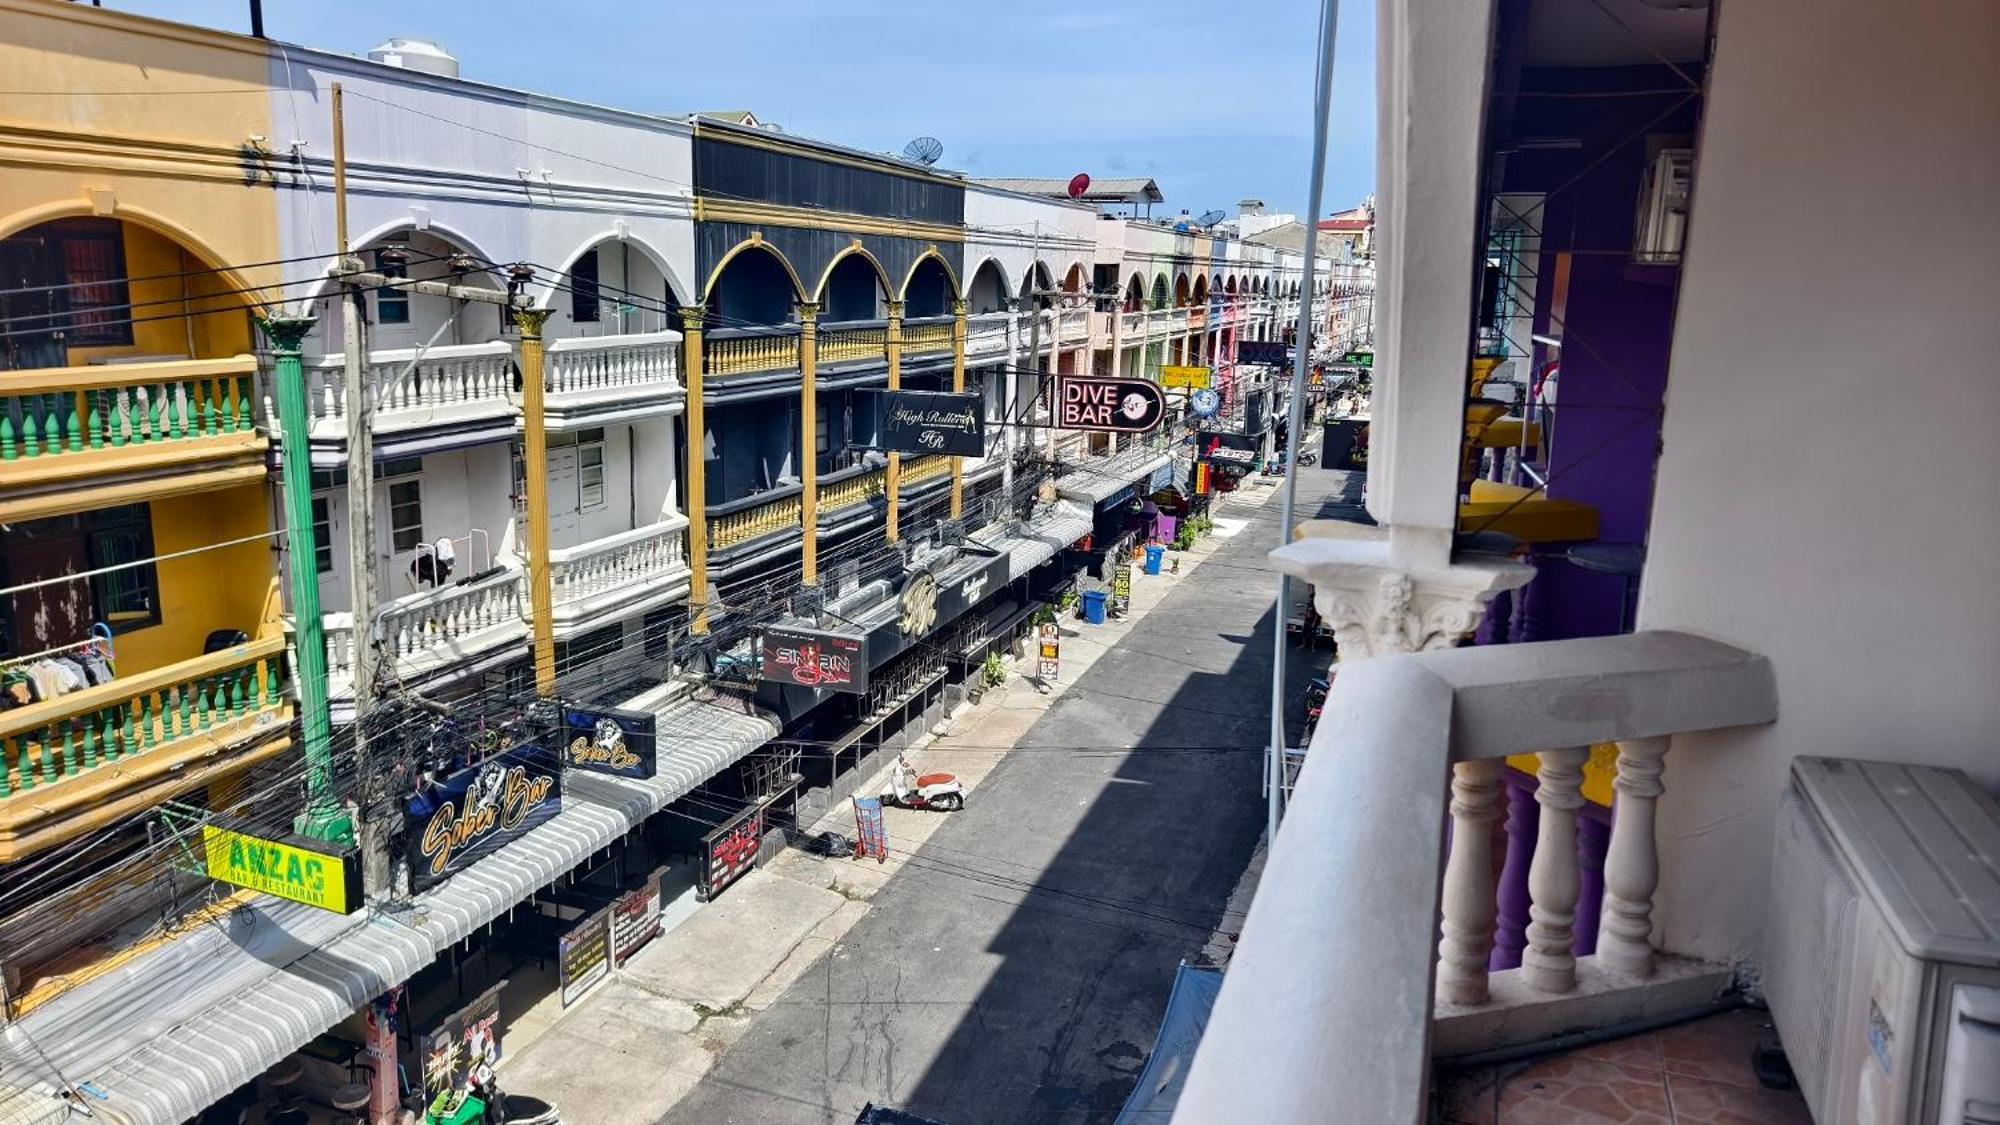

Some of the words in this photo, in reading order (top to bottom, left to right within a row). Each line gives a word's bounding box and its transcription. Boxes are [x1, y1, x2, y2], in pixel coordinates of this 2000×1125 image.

[1066, 384, 1118, 405] DIVE
[894, 409, 925, 426] High
[1066, 404, 1113, 424] BAR
[570, 736, 611, 765] Sober
[611, 736, 642, 769] Bar
[421, 801, 501, 876] Sober
[501, 765, 553, 831] Bar
[262, 876, 325, 904] RESTAURANT
